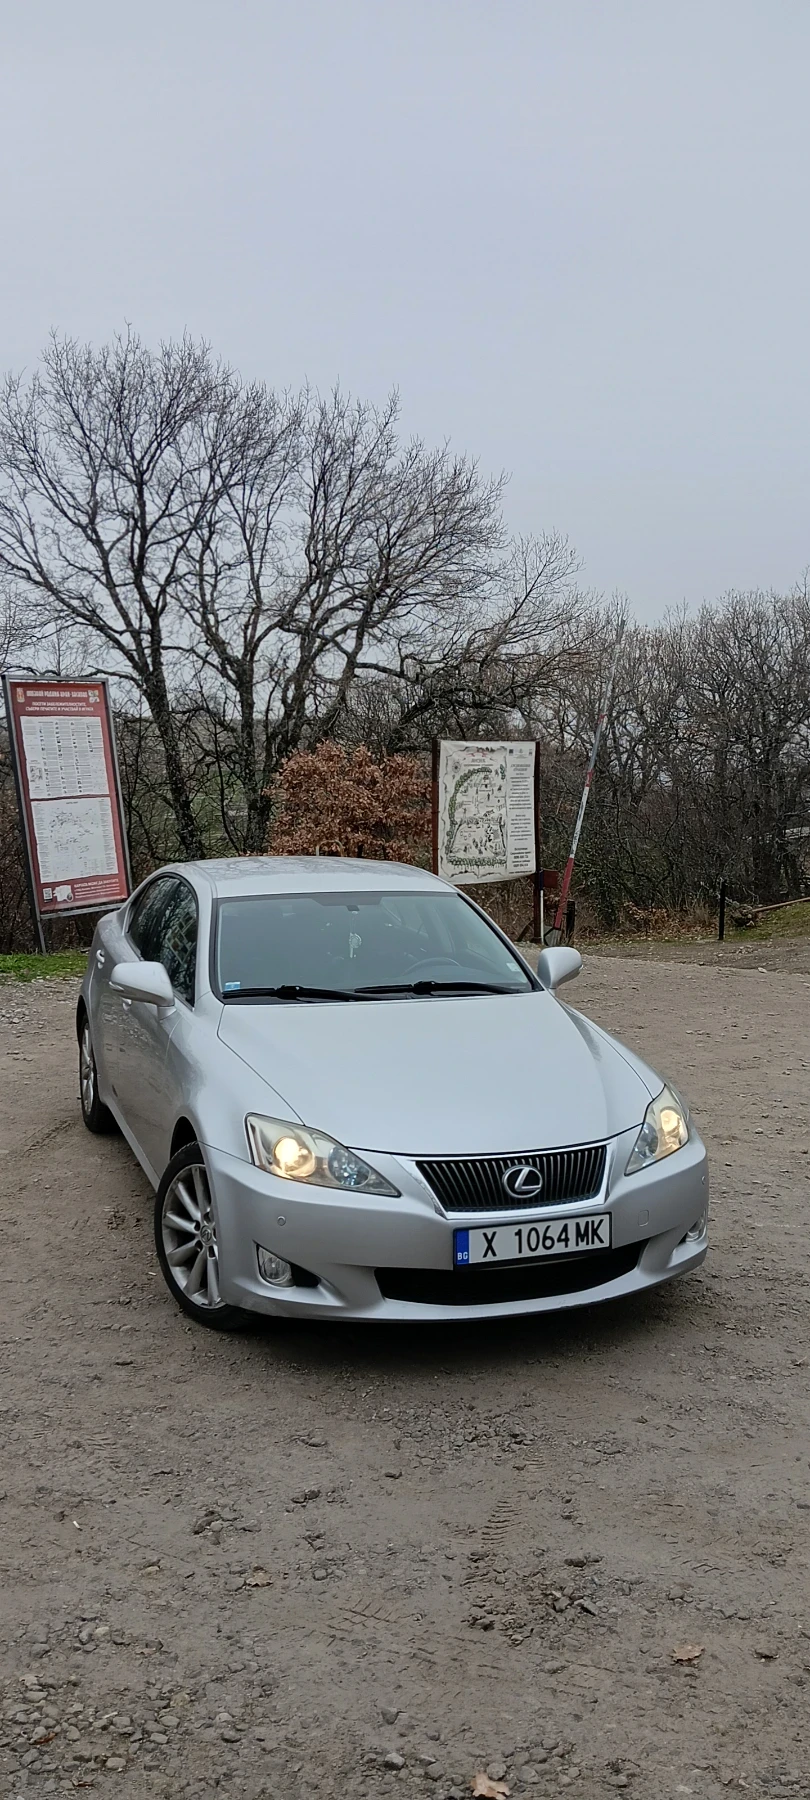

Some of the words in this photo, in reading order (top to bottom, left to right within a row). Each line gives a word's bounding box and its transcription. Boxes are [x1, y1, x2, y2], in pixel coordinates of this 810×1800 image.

[457, 1252, 468, 1260] BG
[482, 1231, 497, 1258] X
[514, 1223, 570, 1254] 1064
[575, 1218, 605, 1247] MK
